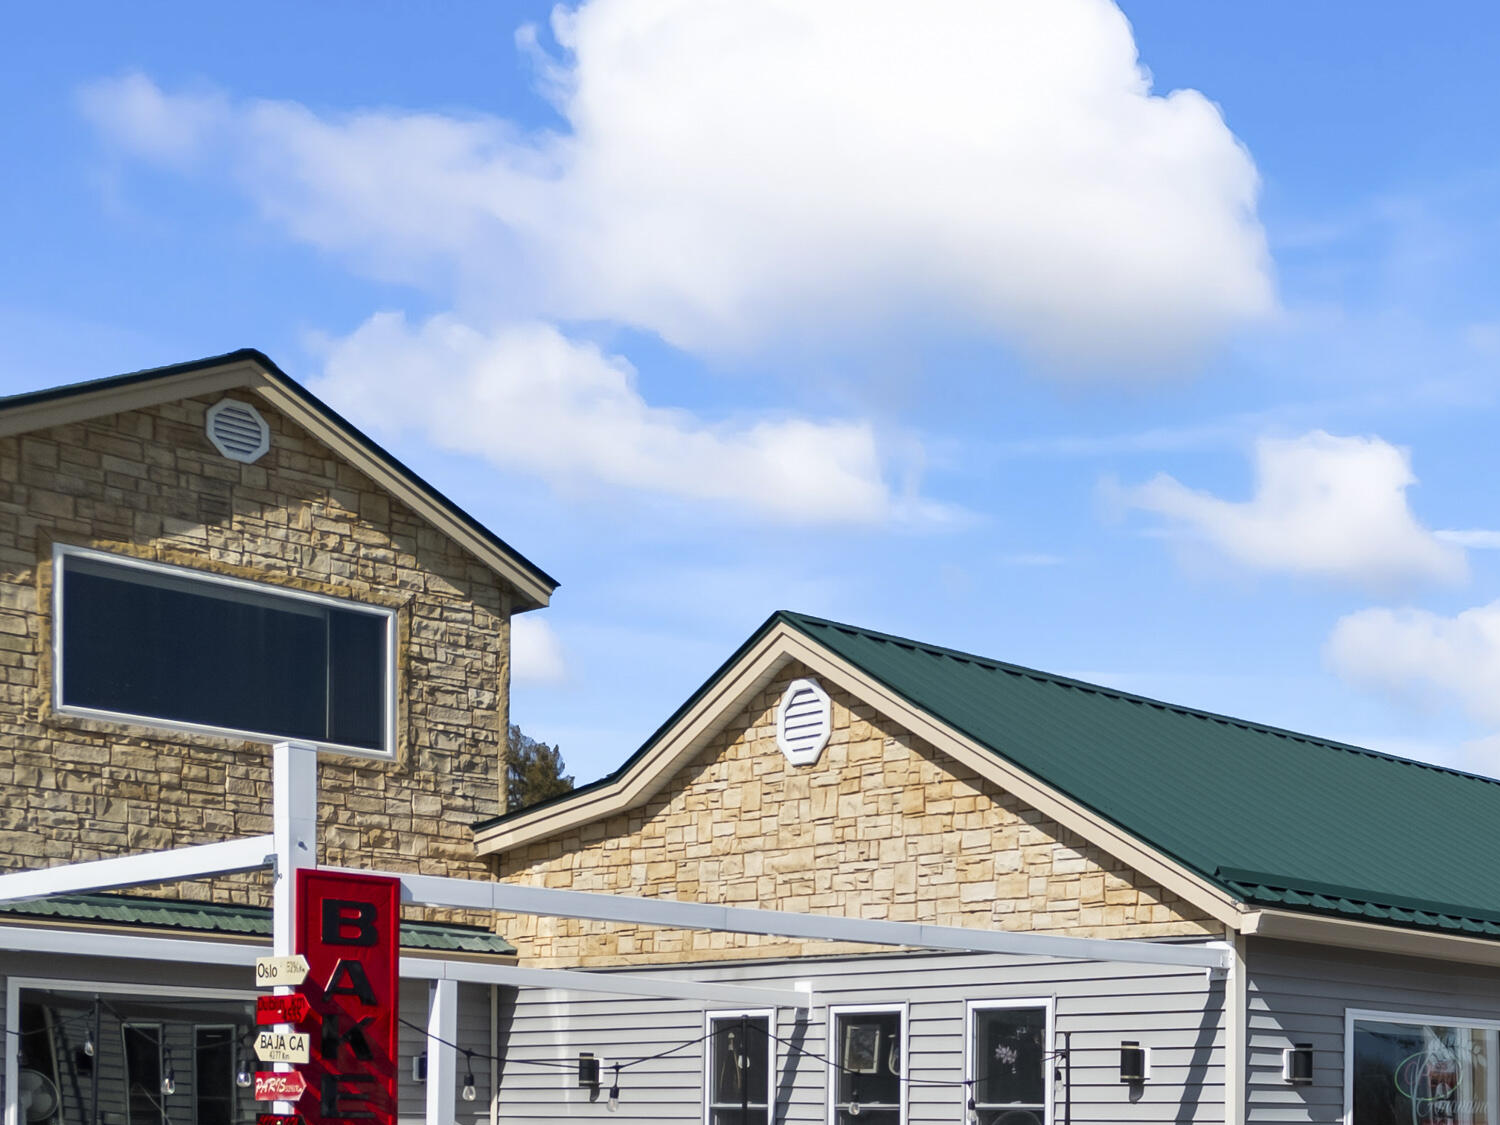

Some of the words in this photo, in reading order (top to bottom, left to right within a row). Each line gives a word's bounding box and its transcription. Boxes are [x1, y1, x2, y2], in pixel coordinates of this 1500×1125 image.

[257, 963, 278, 978] Oslo
[261, 1034, 286, 1050] BAJA
[289, 1035, 305, 1051] CA
[256, 1077, 287, 1094] PARIS
